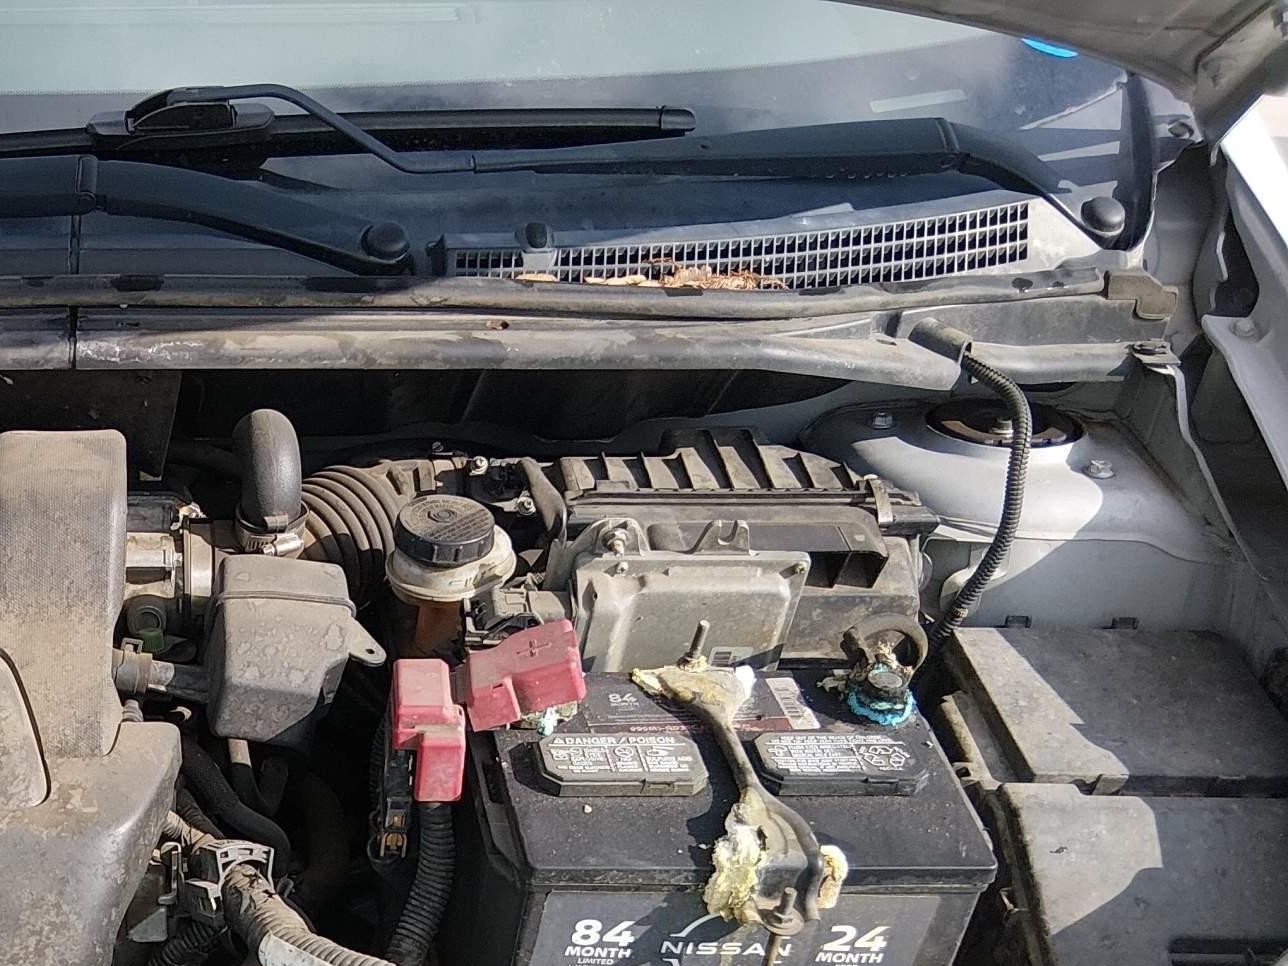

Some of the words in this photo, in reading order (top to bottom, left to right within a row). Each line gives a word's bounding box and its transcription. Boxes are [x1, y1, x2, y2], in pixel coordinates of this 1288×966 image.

[608, 692, 638, 703] 84
[566, 737, 616, 745] DANGER
[628, 736, 675, 744] POISON
[571, 919, 636, 947] 84
[822, 925, 891, 952] 24
[564, 946, 633, 958] MONTH
[660, 940, 793, 957] NISSAN
[577, 957, 615, 966] LIMITED
[815, 951, 884, 964] MONTH
